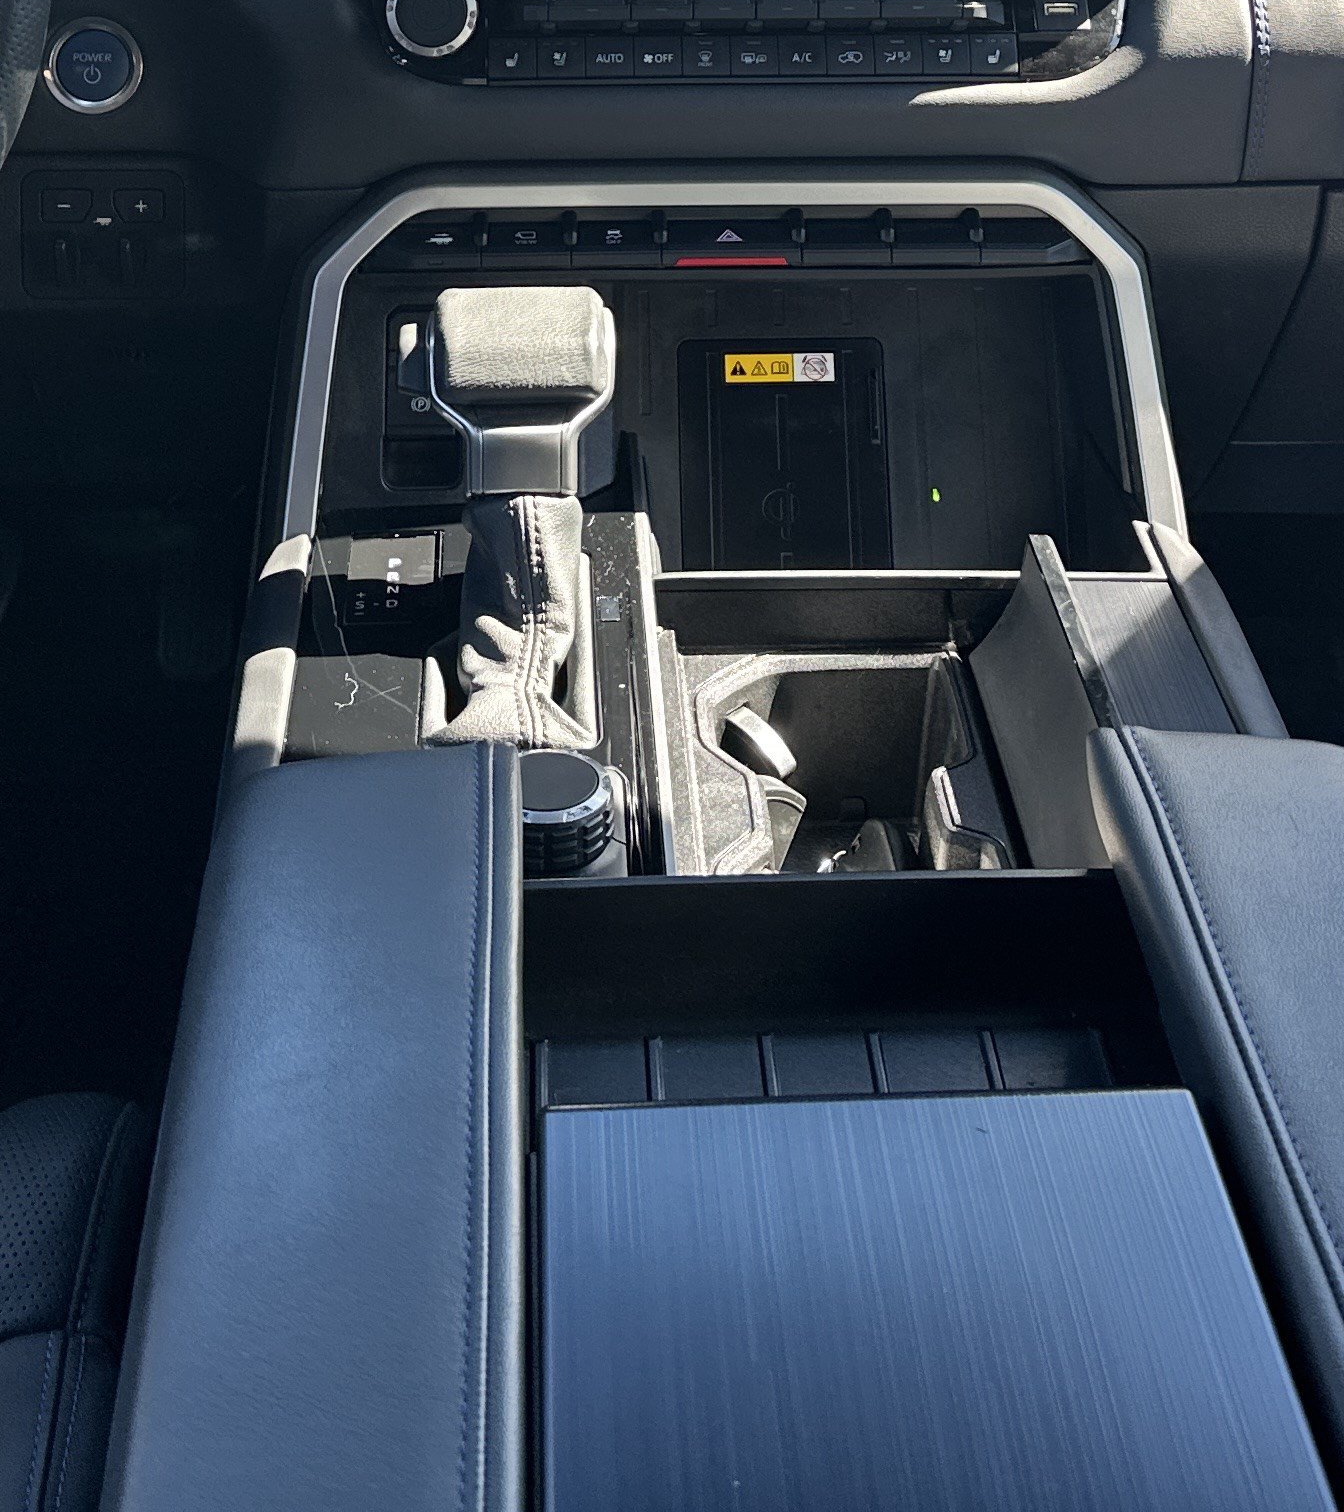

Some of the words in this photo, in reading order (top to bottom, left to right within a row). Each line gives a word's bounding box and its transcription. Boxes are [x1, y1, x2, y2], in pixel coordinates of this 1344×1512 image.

[72, 52, 112, 63] POWER
[595, 53, 624, 64] AUTO
[654, 53, 674, 64] OFF
[792, 52, 813, 64] A/C
[388, 557, 402, 569] P
[386, 571, 400, 583] R
[386, 585, 400, 594] N
[355, 600, 365, 610] S
[386, 599, 399, 608] D
